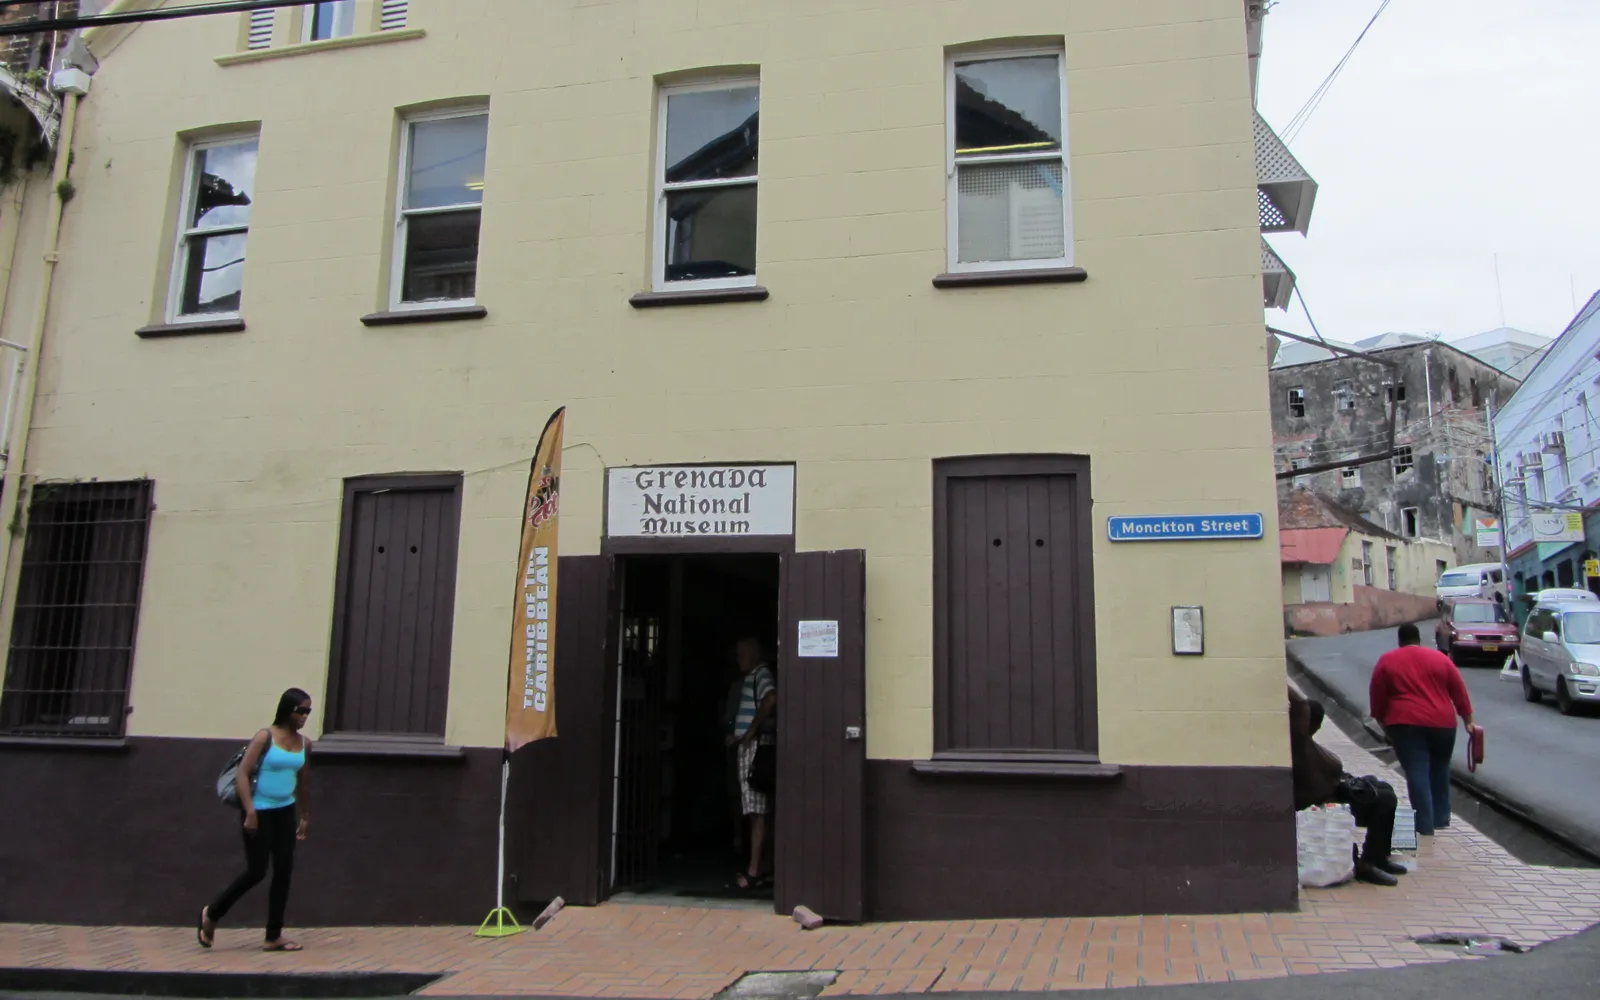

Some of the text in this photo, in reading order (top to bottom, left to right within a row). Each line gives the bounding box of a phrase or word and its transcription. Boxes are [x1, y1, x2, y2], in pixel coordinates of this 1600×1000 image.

[642, 492, 751, 515] National
[639, 517, 750, 535] Museum
[1122, 519, 1248, 533] Monckton Street
[525, 593, 536, 619] OF
[535, 546, 549, 712] CARIBBEAN
[523, 624, 536, 709] TITANIC
